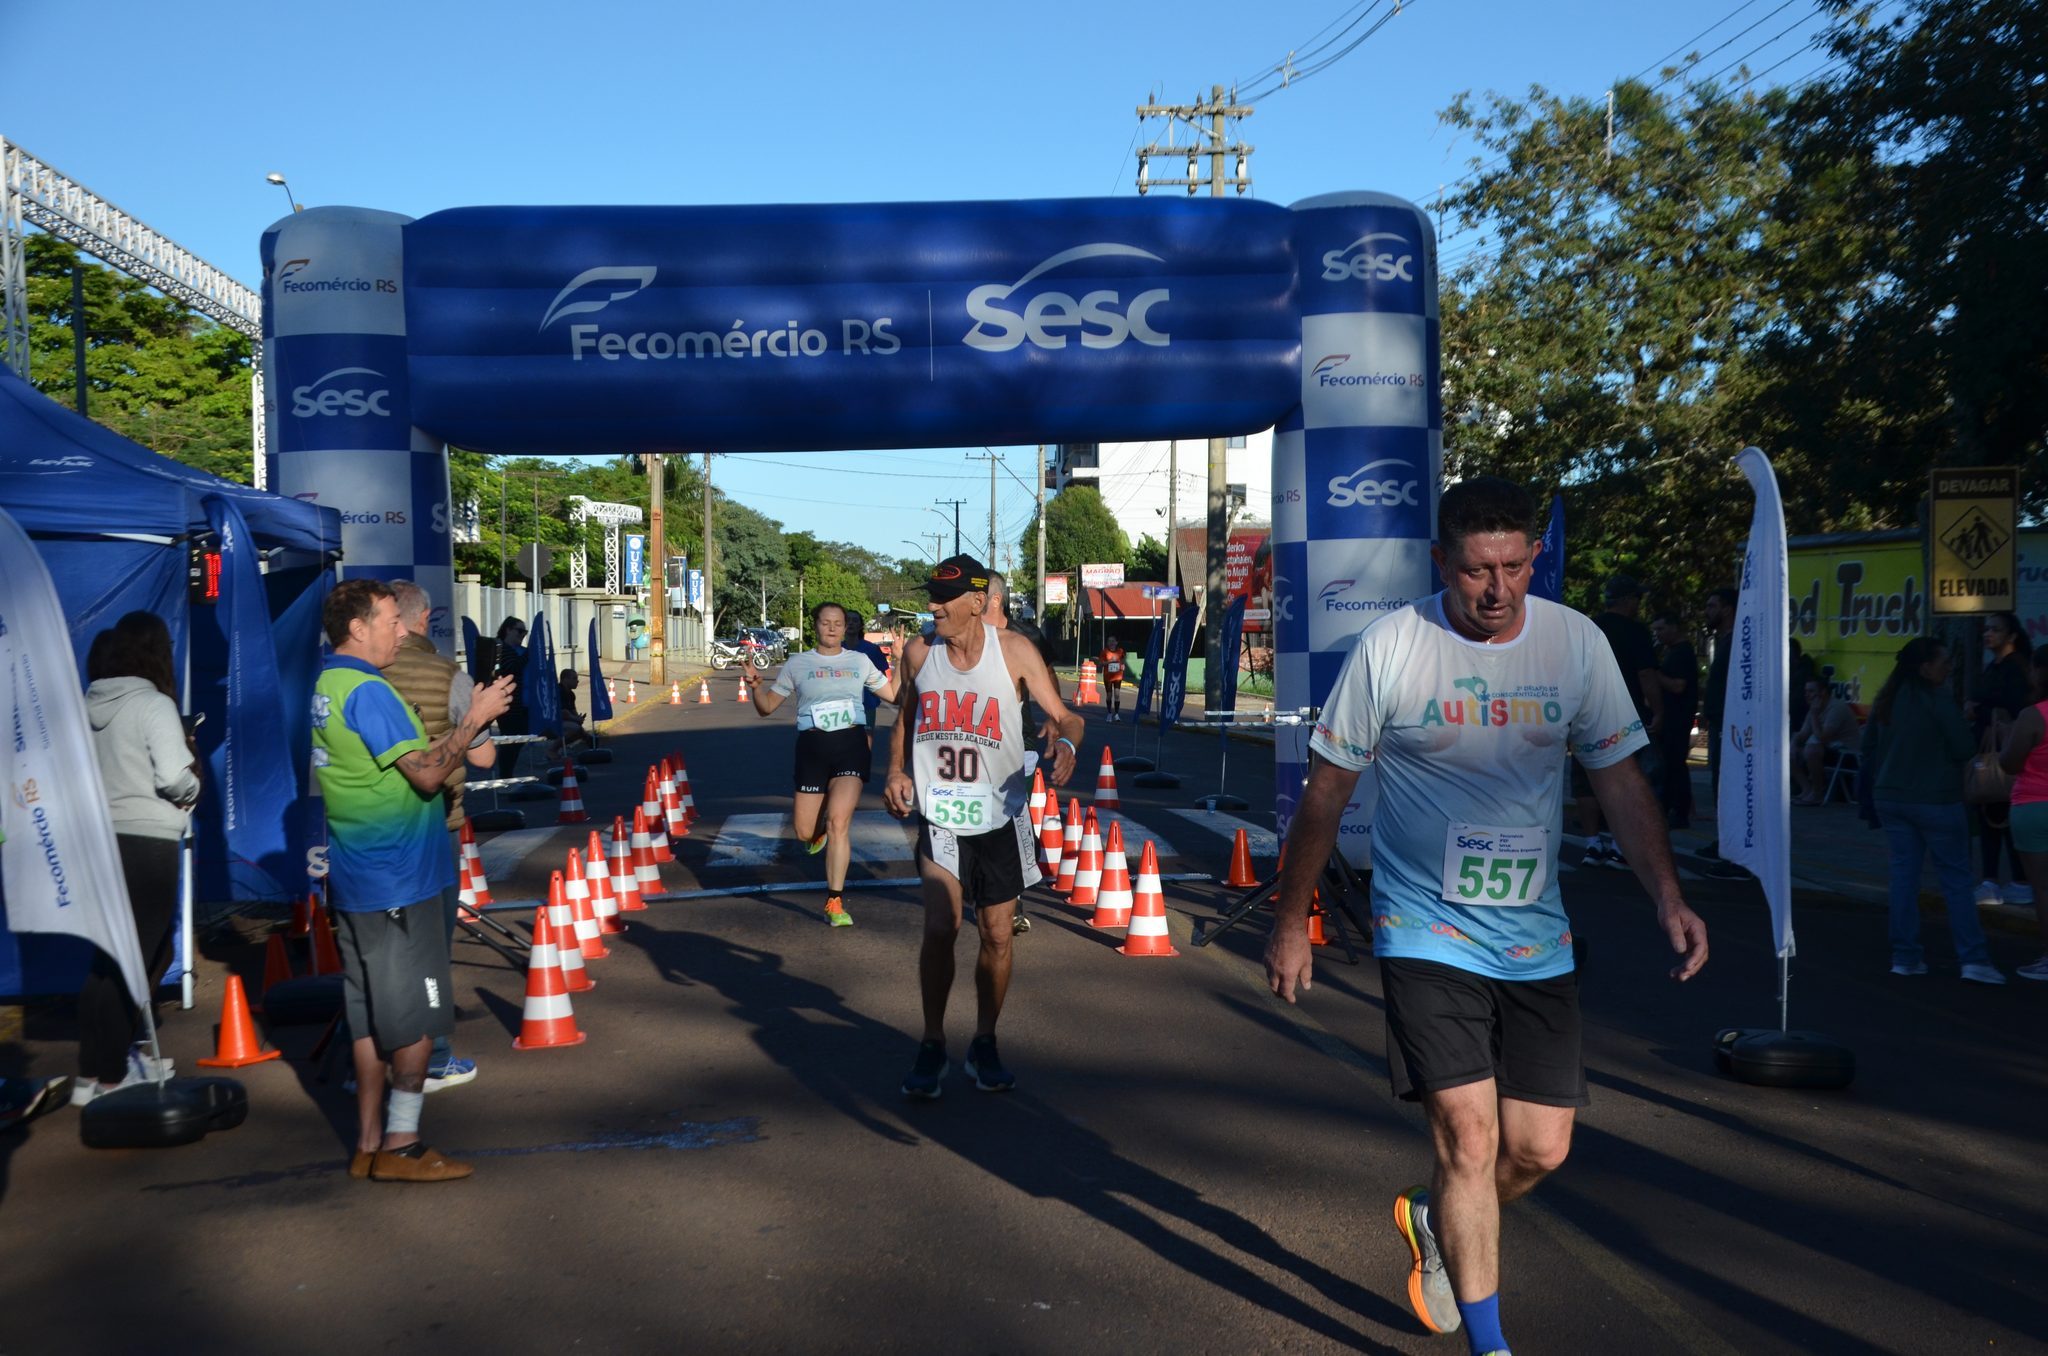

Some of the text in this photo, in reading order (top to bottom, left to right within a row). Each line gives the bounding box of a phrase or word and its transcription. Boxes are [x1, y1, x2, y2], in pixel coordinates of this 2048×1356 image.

[1321, 250, 1414, 283] Sesc
[284, 277, 398, 293] Fecomércio RS
[962, 283, 1171, 352] Sesc
[570, 317, 902, 361] Fecomércio RS
[1320, 372, 1425, 387] Fecomércio RS
[291, 385, 391, 418] Sesc
[1286, 489, 1301, 502] RS
[1327, 475, 1419, 507] Sesc
[1939, 478, 2011, 494] DEVAGAR
[385, 511, 406, 524] RS
[629, 551, 640, 584] URI
[1789, 560, 1924, 638] od Truck
[1939, 578, 2010, 597] ELEVADA
[1740, 615, 1753, 701] Sindicatos
[807, 670, 860, 681] Autismo
[820, 710, 852, 730] 374
[918, 689, 1003, 741] RMA
[1421, 696, 1563, 728] Autismo
[916, 732, 1001, 750] REDE MESTRE ACADEMIA
[937, 745, 980, 783] 30
[1744, 724, 1753, 849] Fecomércio RS
[935, 799, 983, 826] 536
[22, 777, 71, 909] Fecomércio RS
[1456, 835, 1494, 852] Sesc
[1457, 855, 1538, 901] 557
